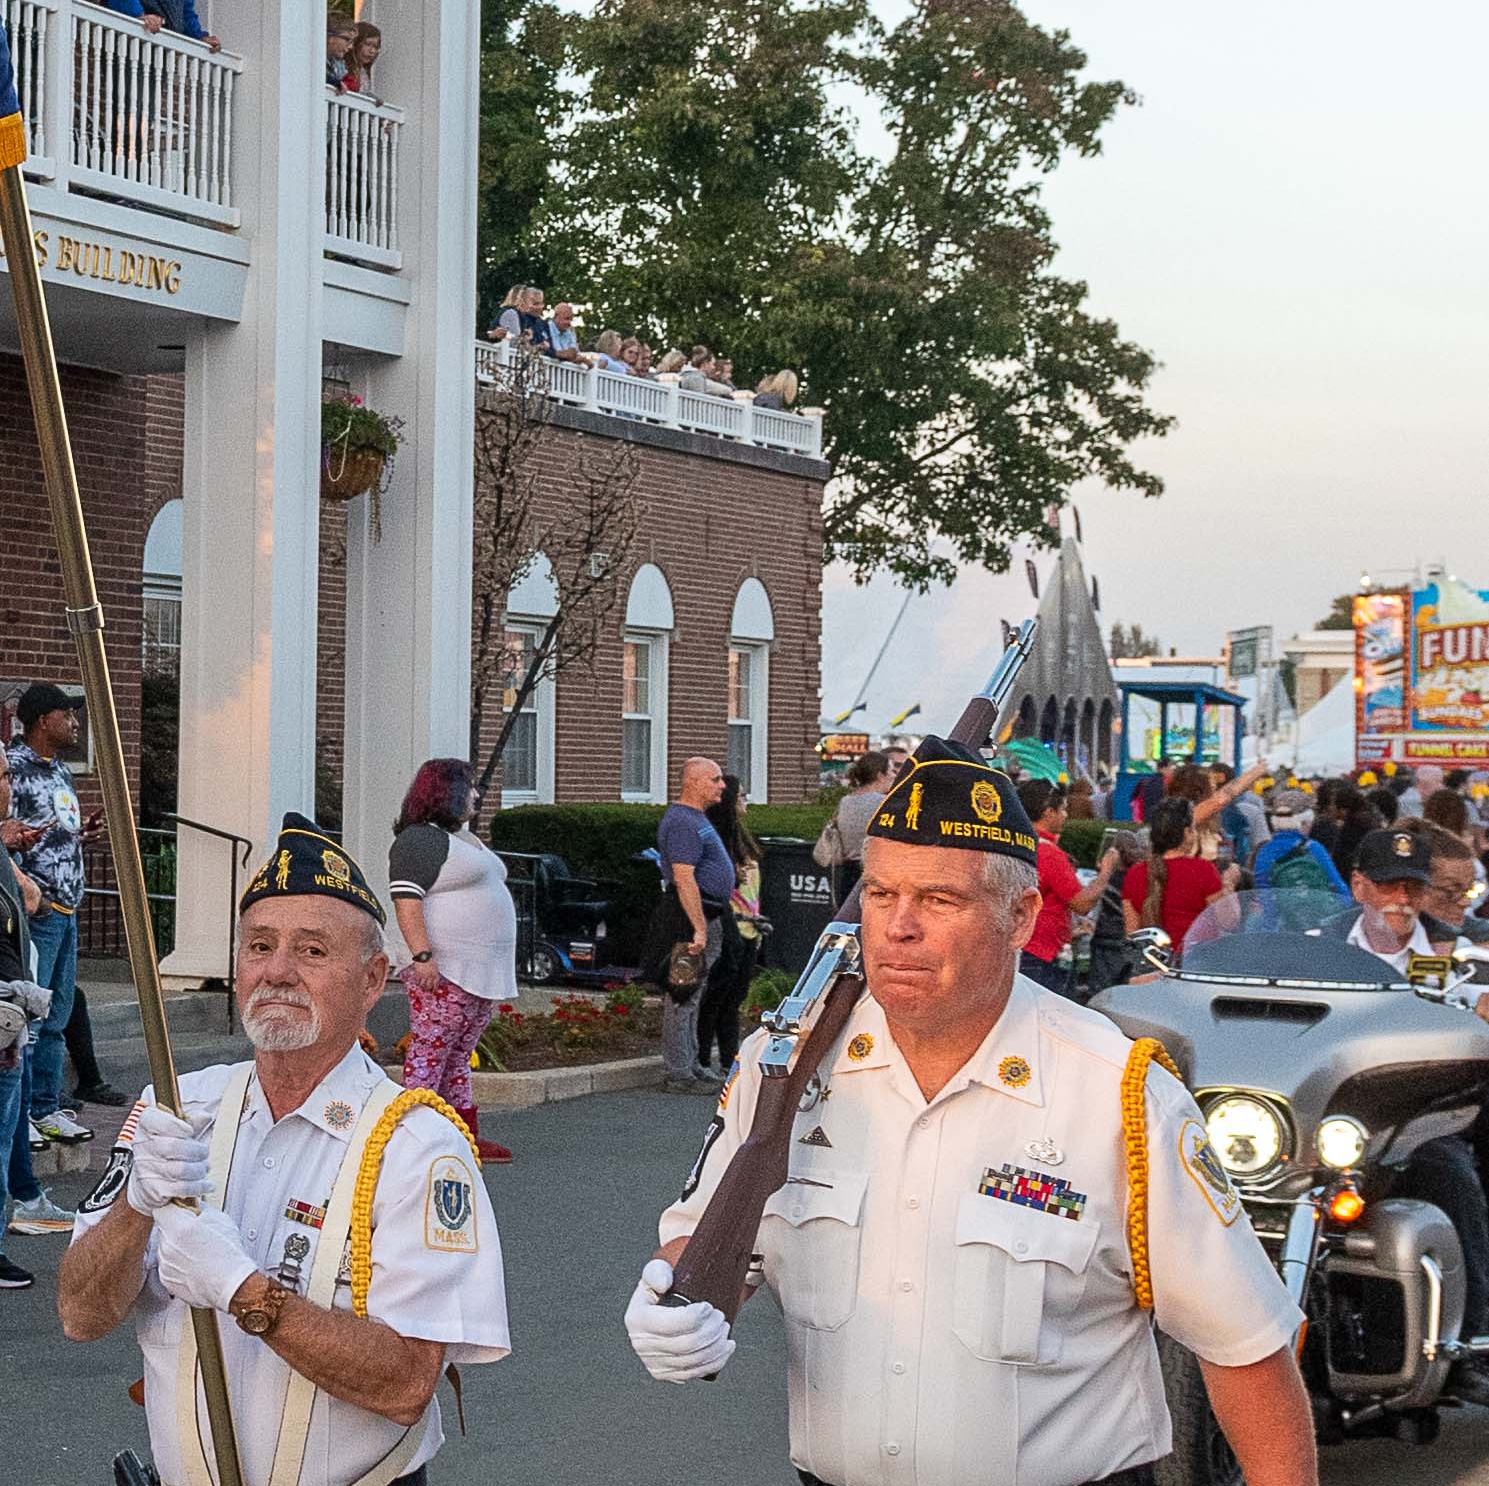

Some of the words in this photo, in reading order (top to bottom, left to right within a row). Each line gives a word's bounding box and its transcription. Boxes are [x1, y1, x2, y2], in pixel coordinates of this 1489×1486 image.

[55, 235, 182, 295] BUILDING
[939, 820, 1015, 846] WESTFIELD,
[790, 874, 831, 893] USA
